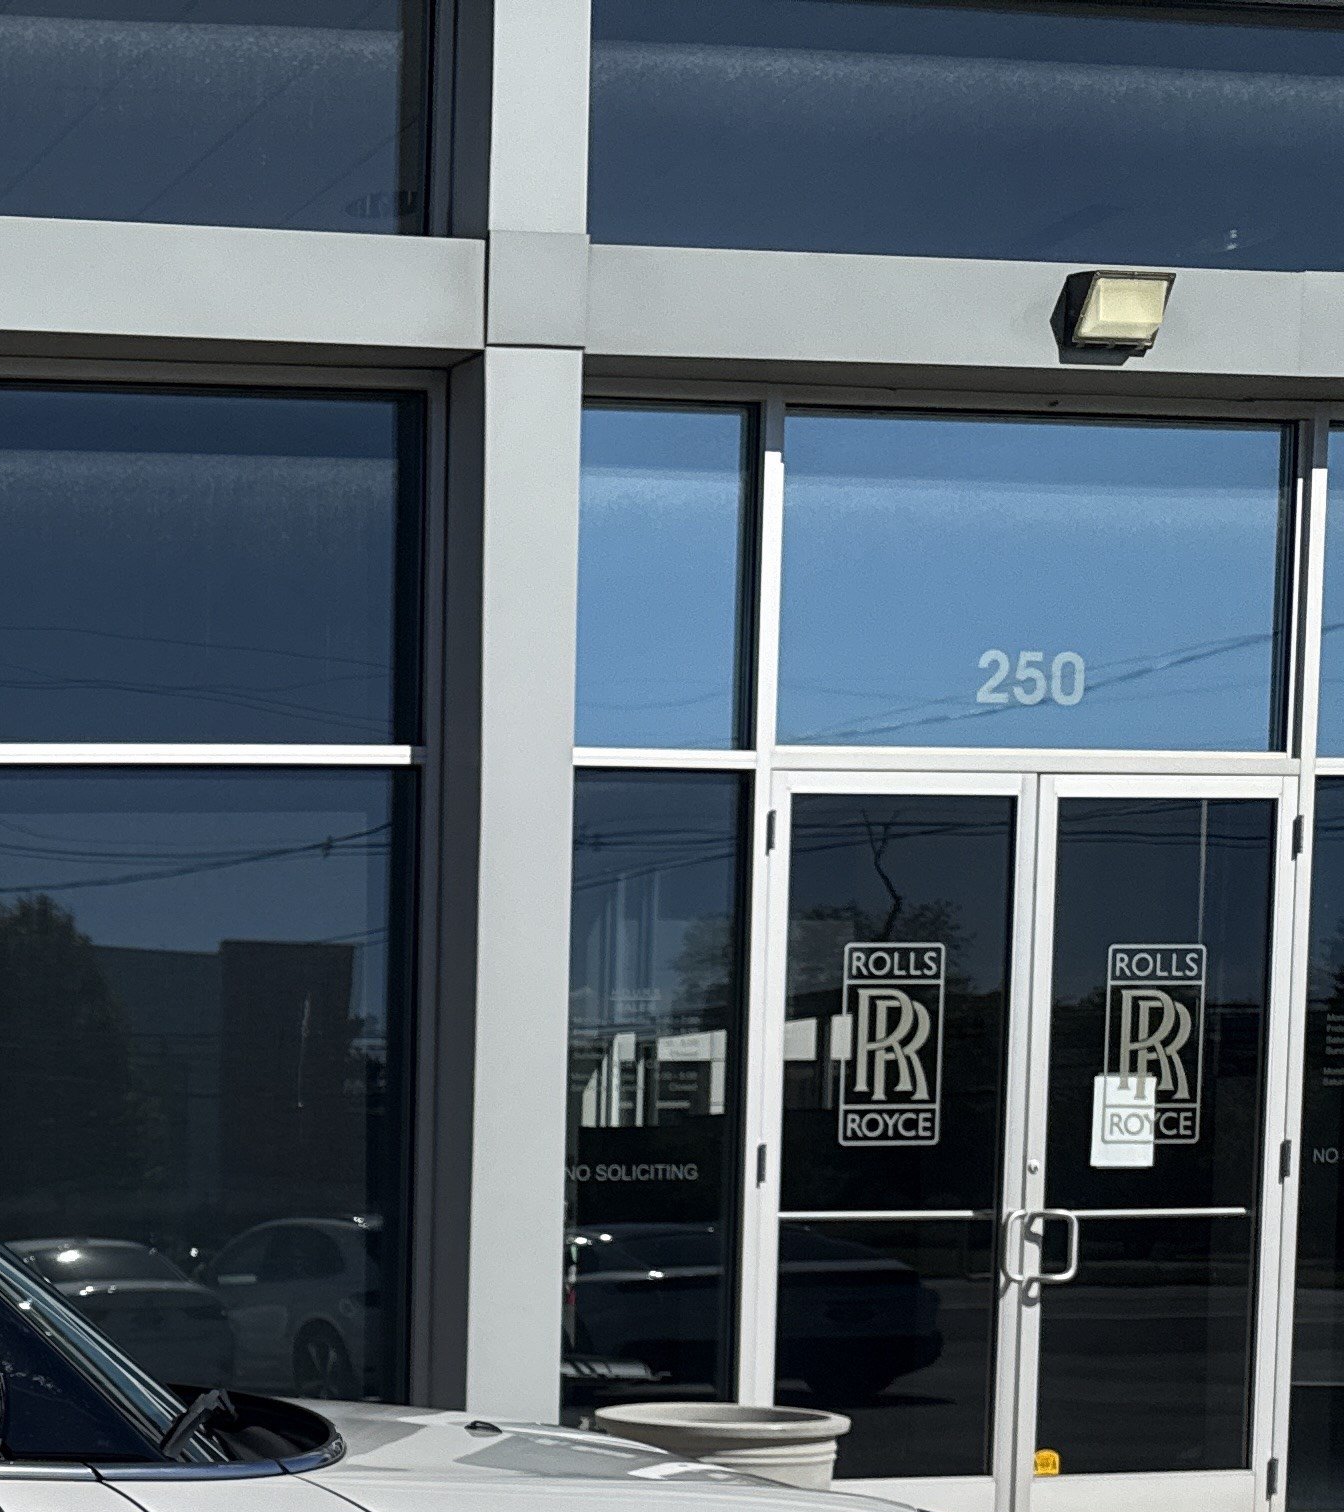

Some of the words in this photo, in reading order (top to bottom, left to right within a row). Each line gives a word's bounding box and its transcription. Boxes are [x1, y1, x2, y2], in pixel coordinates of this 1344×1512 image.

[976, 649, 1085, 705] 250
[851, 951, 937, 976] ROLLS
[1115, 952, 1199, 977] ROLLS
[846, 1112, 932, 1137] ROYCE
[1109, 1111, 1193, 1137] ROYCE
[1313, 1147, 1339, 1164] NO
[595, 1163, 700, 1181] SOLICITING
